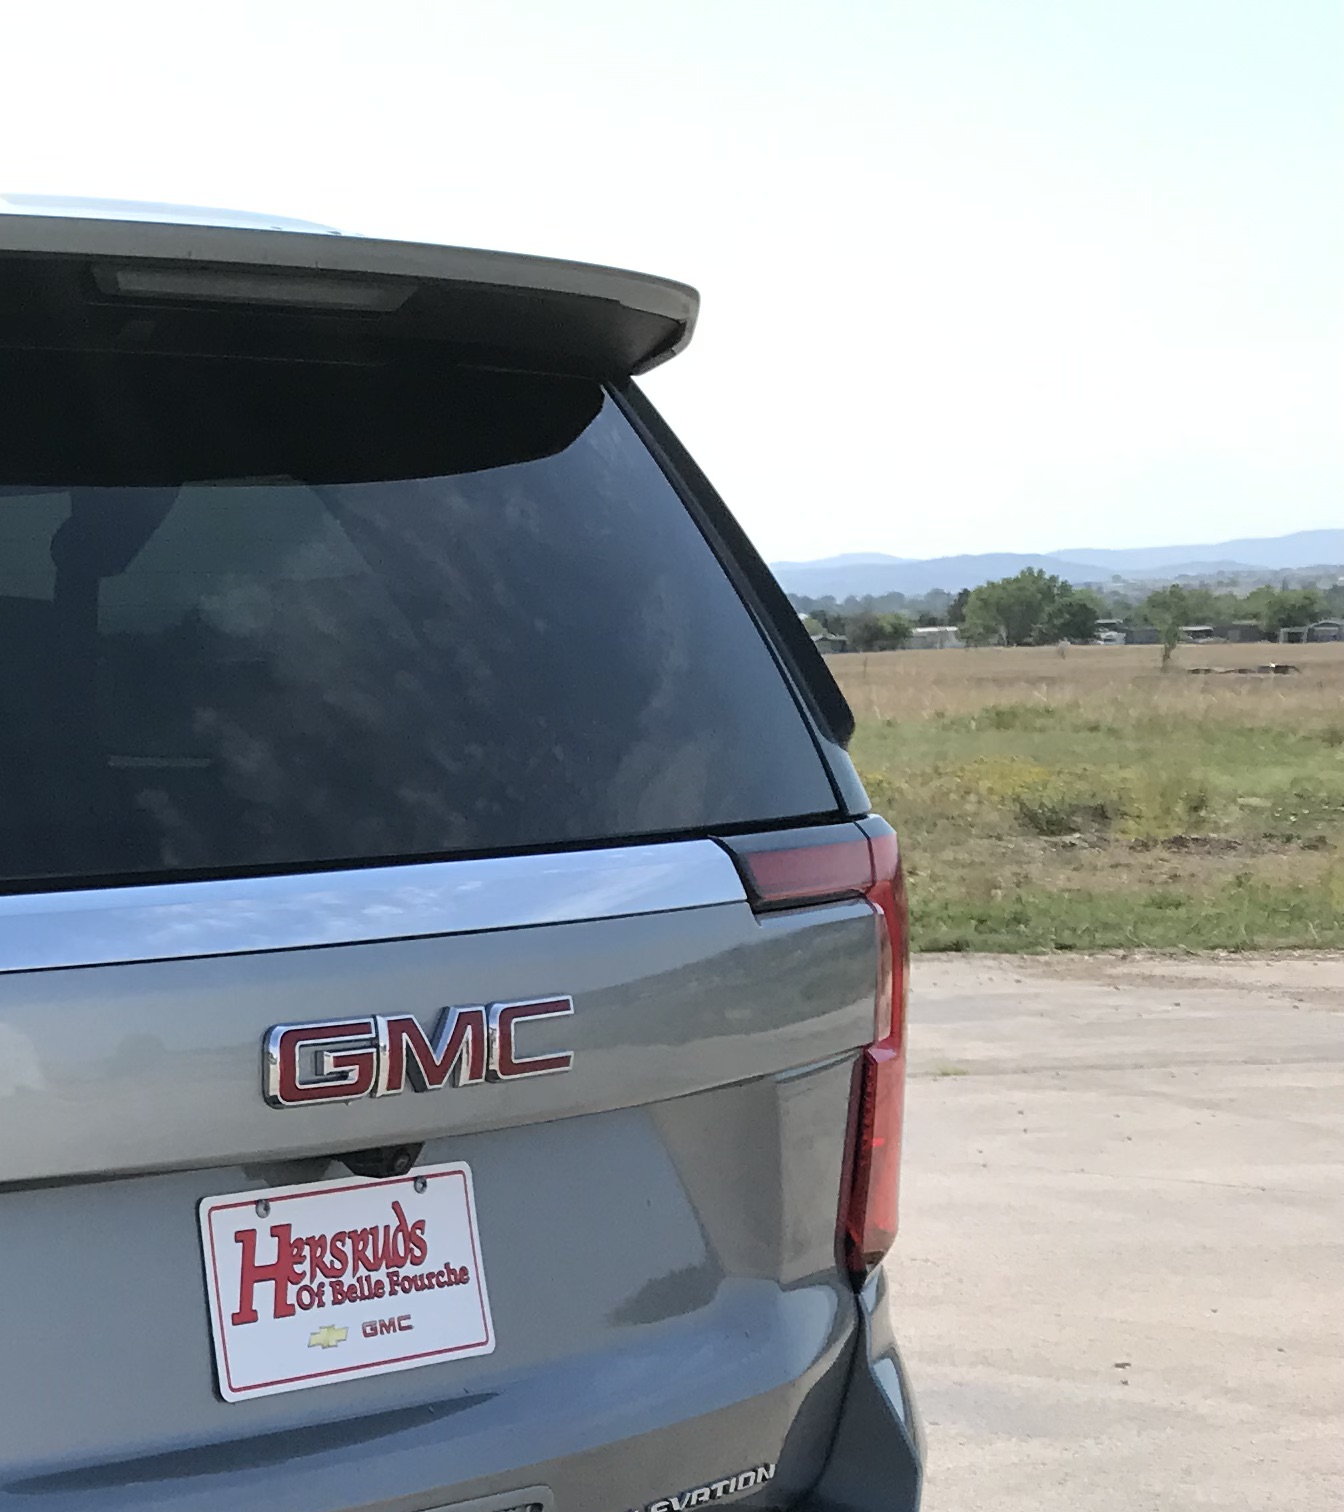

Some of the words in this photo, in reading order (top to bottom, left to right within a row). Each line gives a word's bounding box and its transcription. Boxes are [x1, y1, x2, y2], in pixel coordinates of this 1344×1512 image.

[263, 994, 575, 1108] GMC
[296, 1280, 326, 1311] Of
[329, 1274, 386, 1305] Belle
[386, 1261, 470, 1297] Fourche
[361, 1314, 415, 1338] GMC
